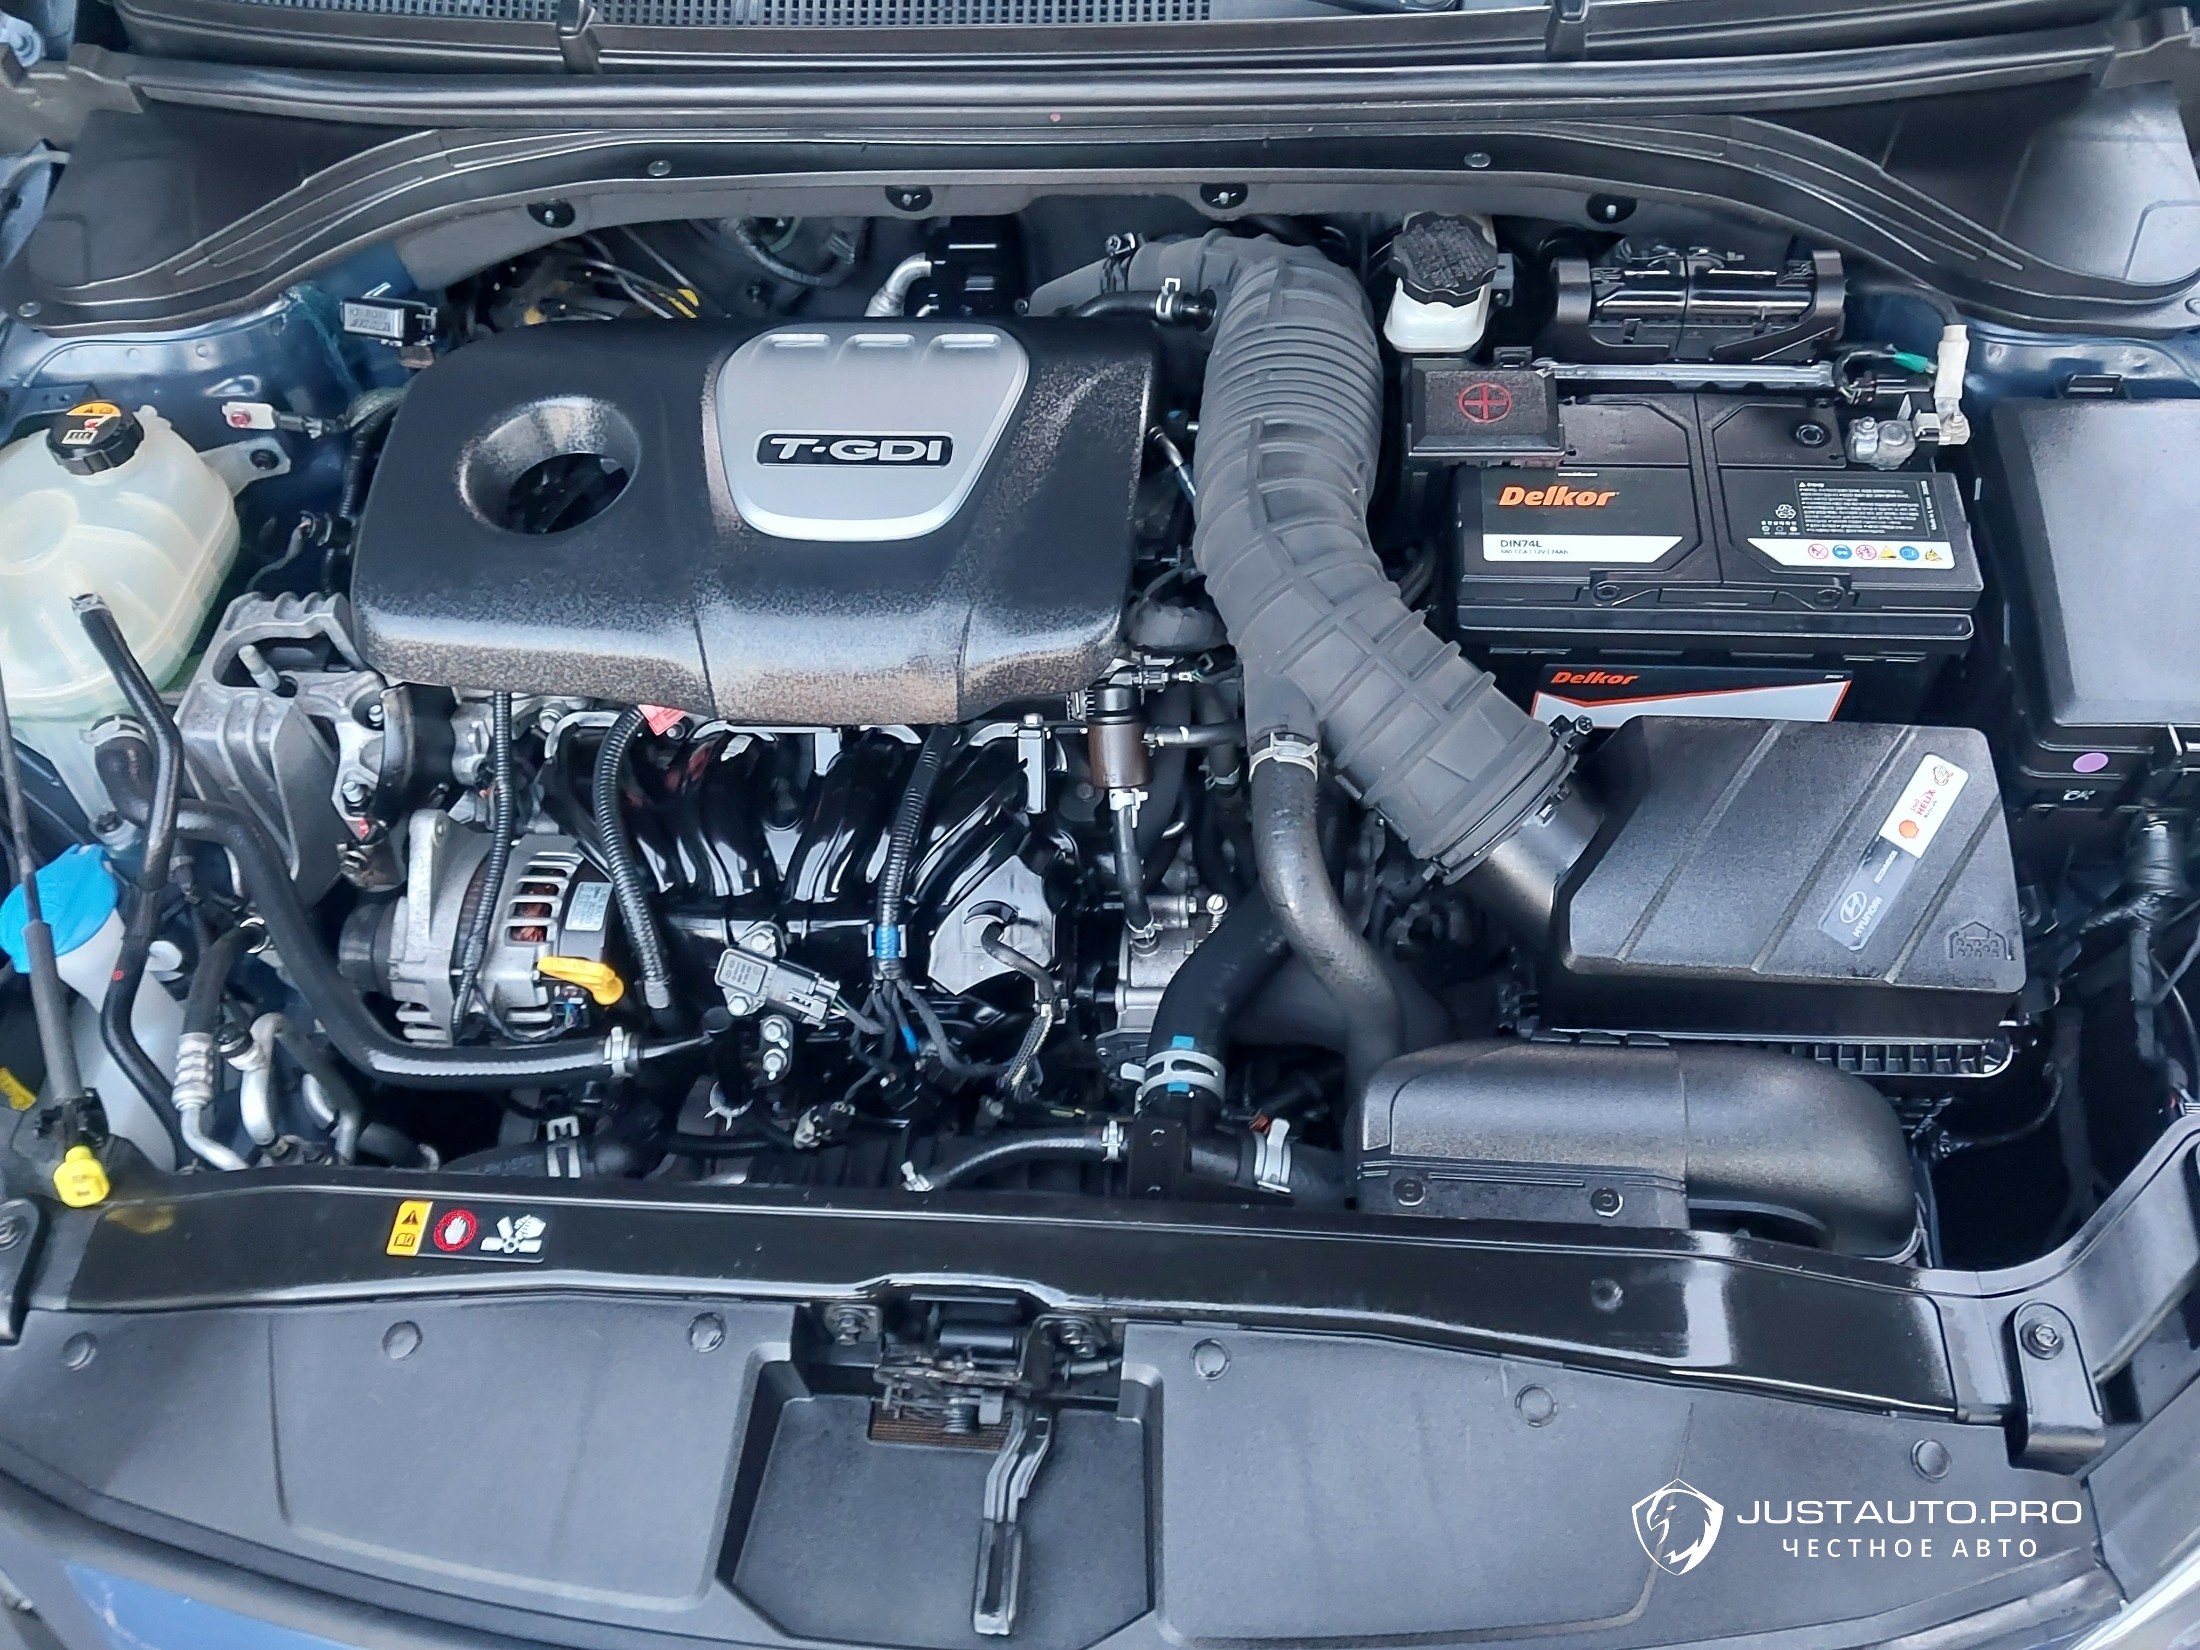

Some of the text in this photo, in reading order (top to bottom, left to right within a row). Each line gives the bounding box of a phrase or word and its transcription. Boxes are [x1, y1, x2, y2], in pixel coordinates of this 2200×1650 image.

[769, 437, 943, 462] T-GDI
[1498, 485, 1617, 507] Delkor
[1500, 539, 1543, 548] DIN74L
[1550, 671, 1640, 686] Delkor
[1915, 788, 1937, 816] HELIX
[1851, 896, 1884, 938] HYUNDAI
